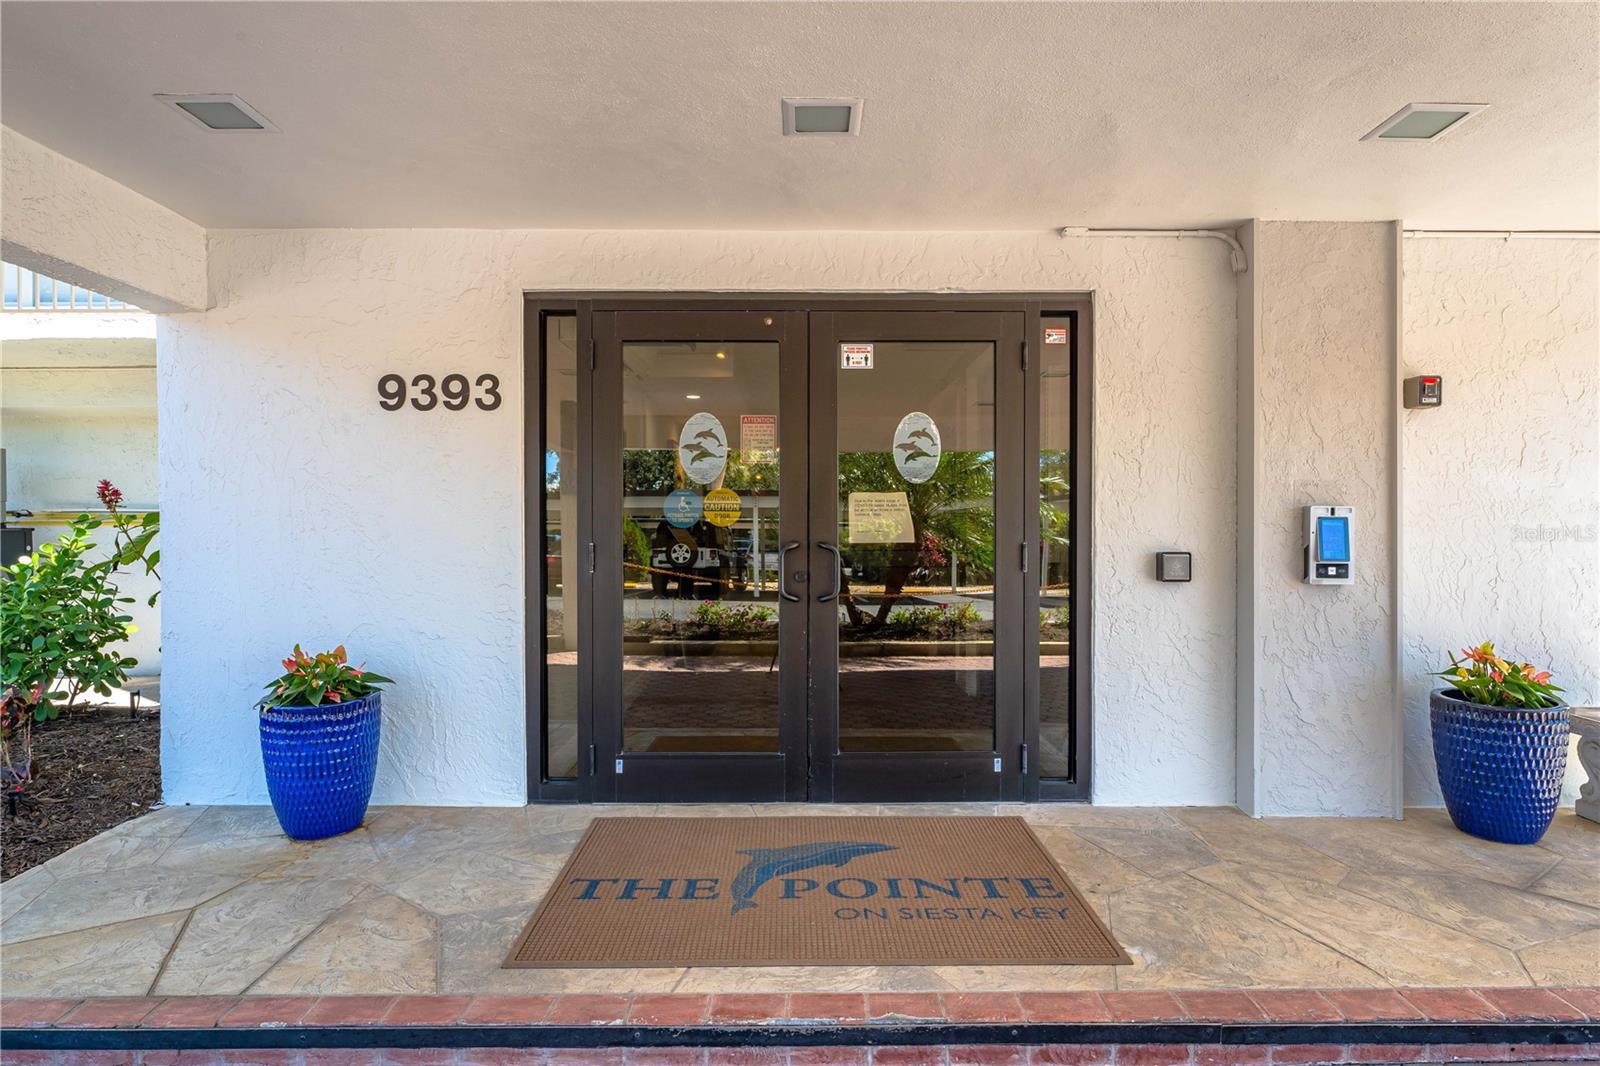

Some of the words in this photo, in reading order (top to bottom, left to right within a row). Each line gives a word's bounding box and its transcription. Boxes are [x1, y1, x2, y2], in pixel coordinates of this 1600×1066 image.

[377, 373, 502, 412] 9393
[704, 503, 740, 511] CAUTION
[569, 878, 721, 900] THE
[778, 877, 1065, 900] POINTE
[833, 906, 889, 921] ON
[898, 906, 1003, 921] SIESTA
[1010, 906, 1070, 921] KEY
